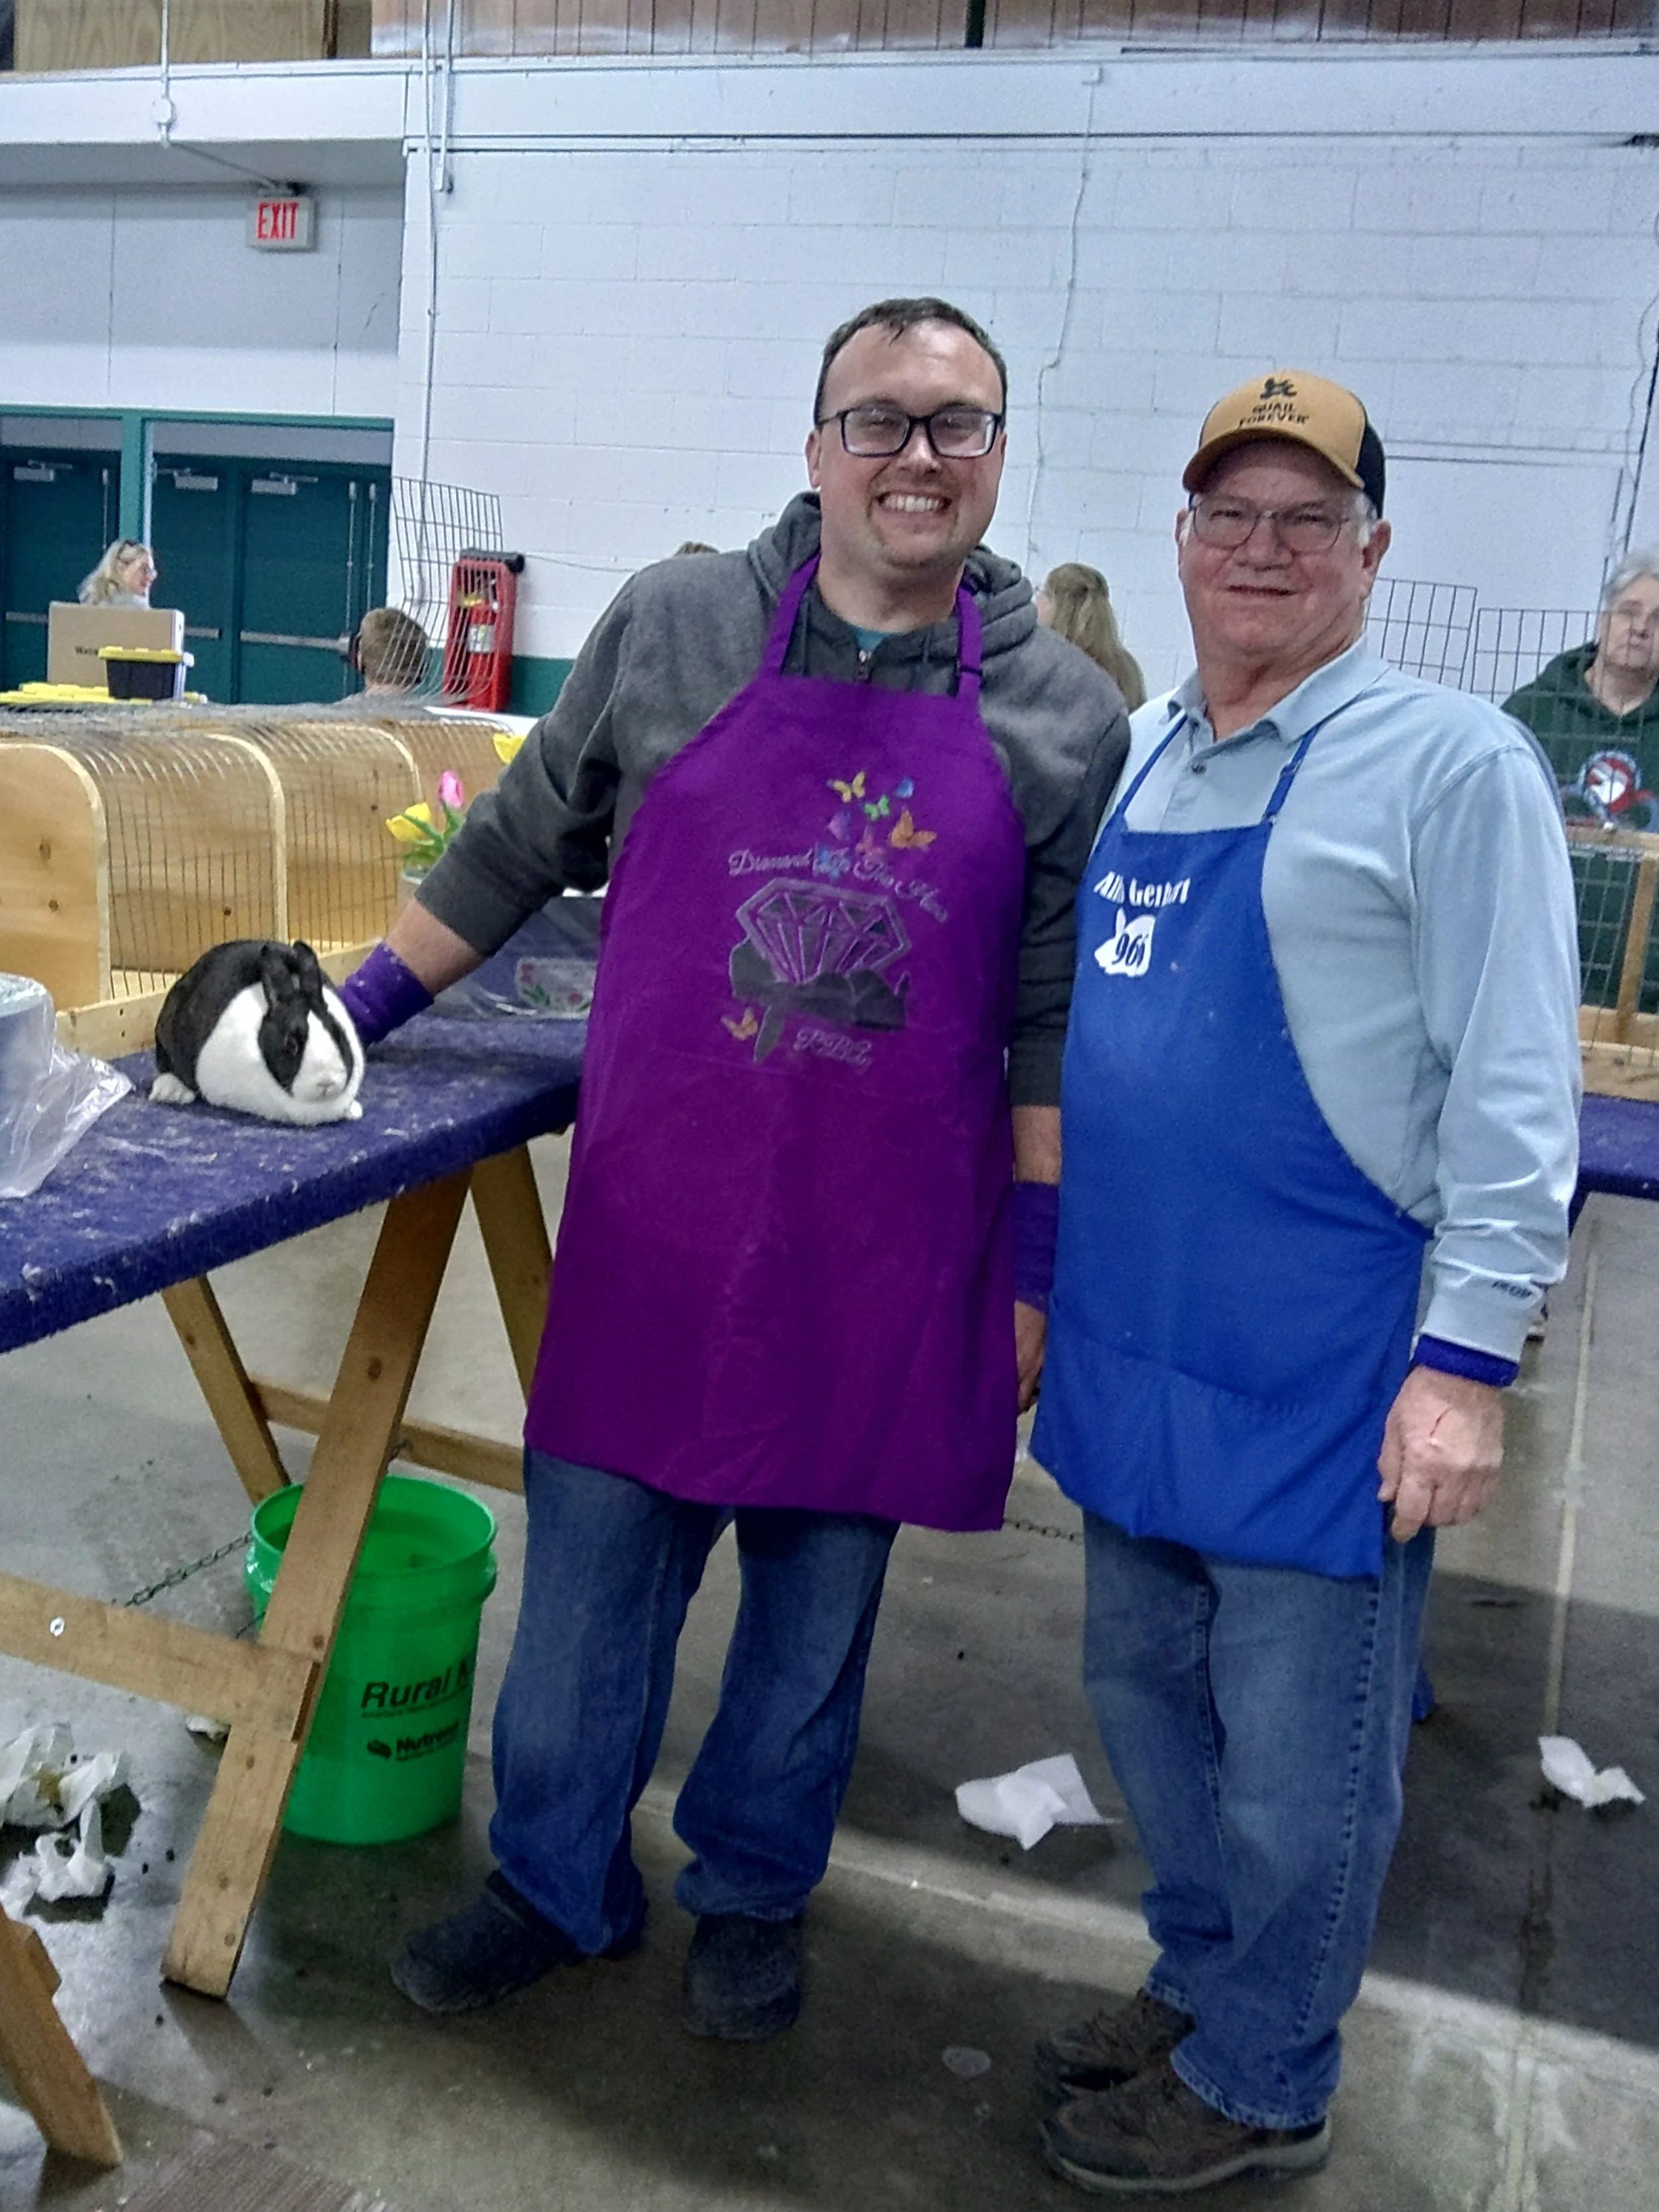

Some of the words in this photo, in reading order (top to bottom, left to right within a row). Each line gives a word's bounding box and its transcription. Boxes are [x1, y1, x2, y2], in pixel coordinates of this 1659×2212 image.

[257, 202, 299, 239] EXIT
[1238, 413, 1307, 427] FOREVER
[1252, 402, 1296, 413] QUAIL
[360, 1666, 452, 1708] Rural
